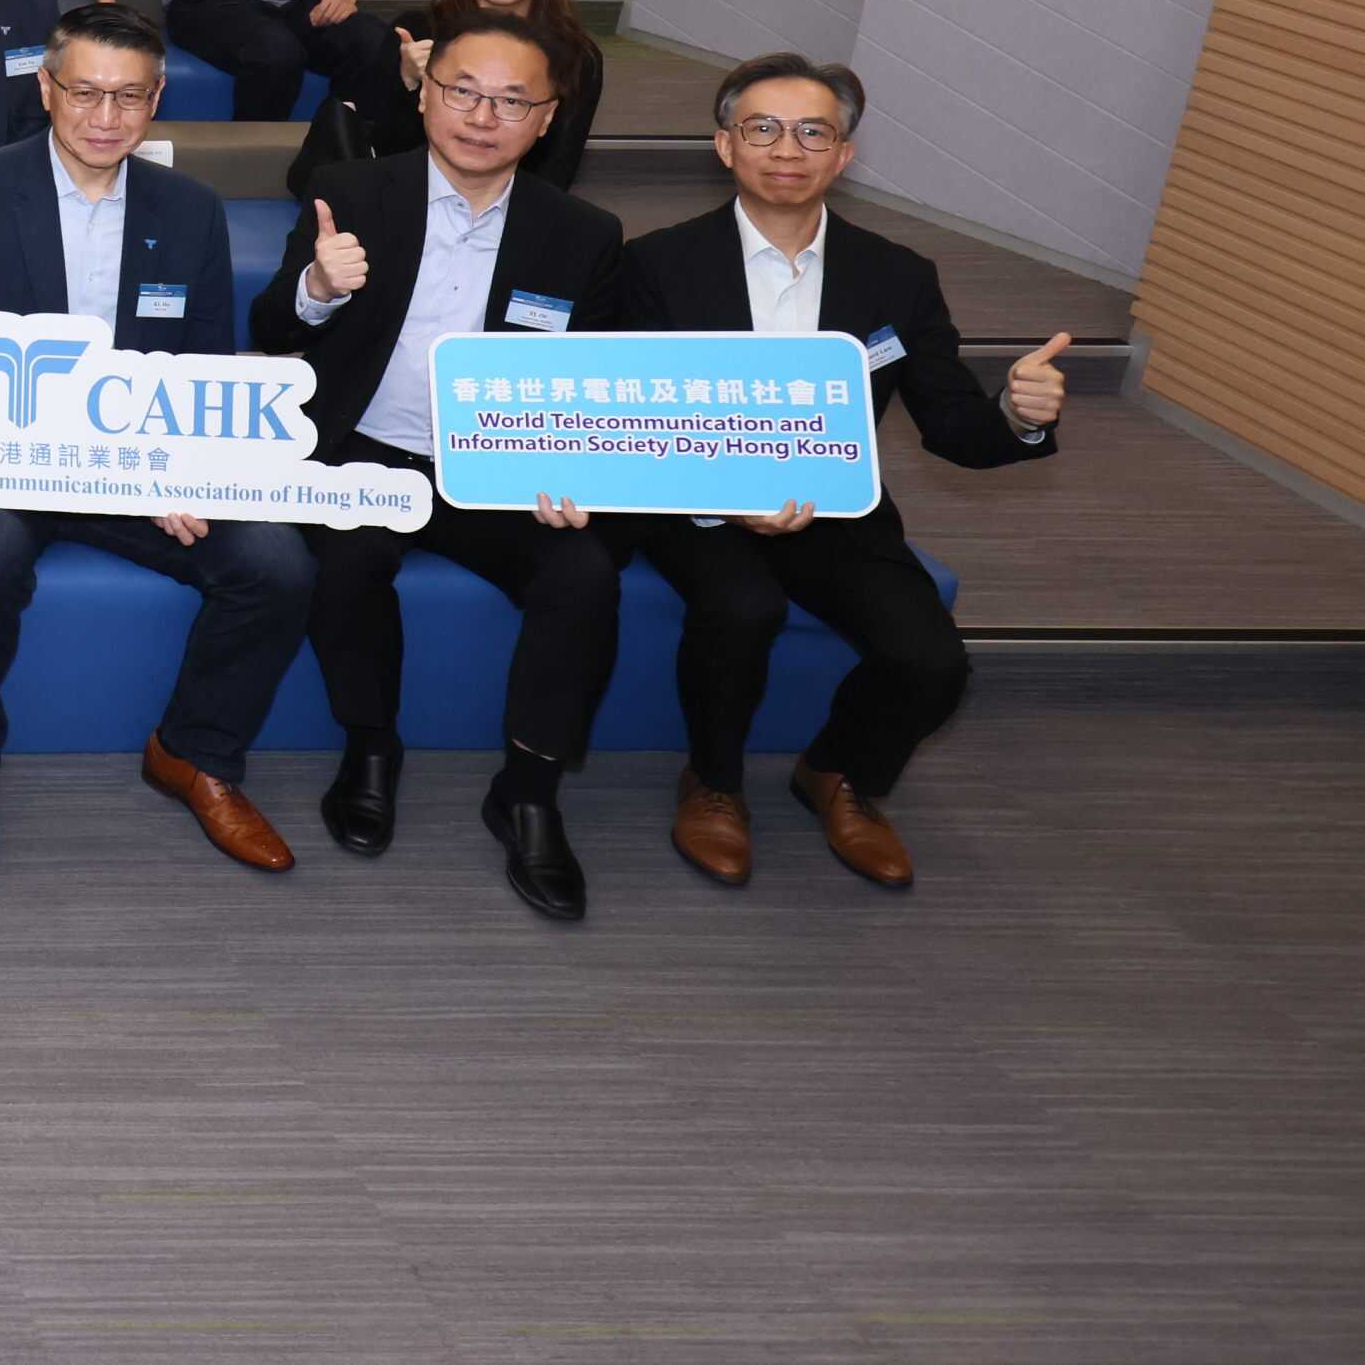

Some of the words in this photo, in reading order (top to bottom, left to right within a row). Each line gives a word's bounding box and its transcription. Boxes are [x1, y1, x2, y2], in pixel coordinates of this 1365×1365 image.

[452, 378, 850, 406] 香港世界電訊及資訊社會日
[87, 374, 295, 442] CAHK
[478, 411, 545, 430] World
[550, 413, 774, 432] Telecommunication
[780, 415, 823, 432] and
[450, 434, 582, 452] Information
[587, 435, 668, 457] Society
[676, 437, 718, 458] Day
[726, 438, 789, 459] Hong
[797, 439, 858, 460] Kong
[147, 478, 264, 502] Association
[270, 484, 292, 504] of
[295, 488, 351, 510] Hong
[358, 488, 412, 512] Kong
